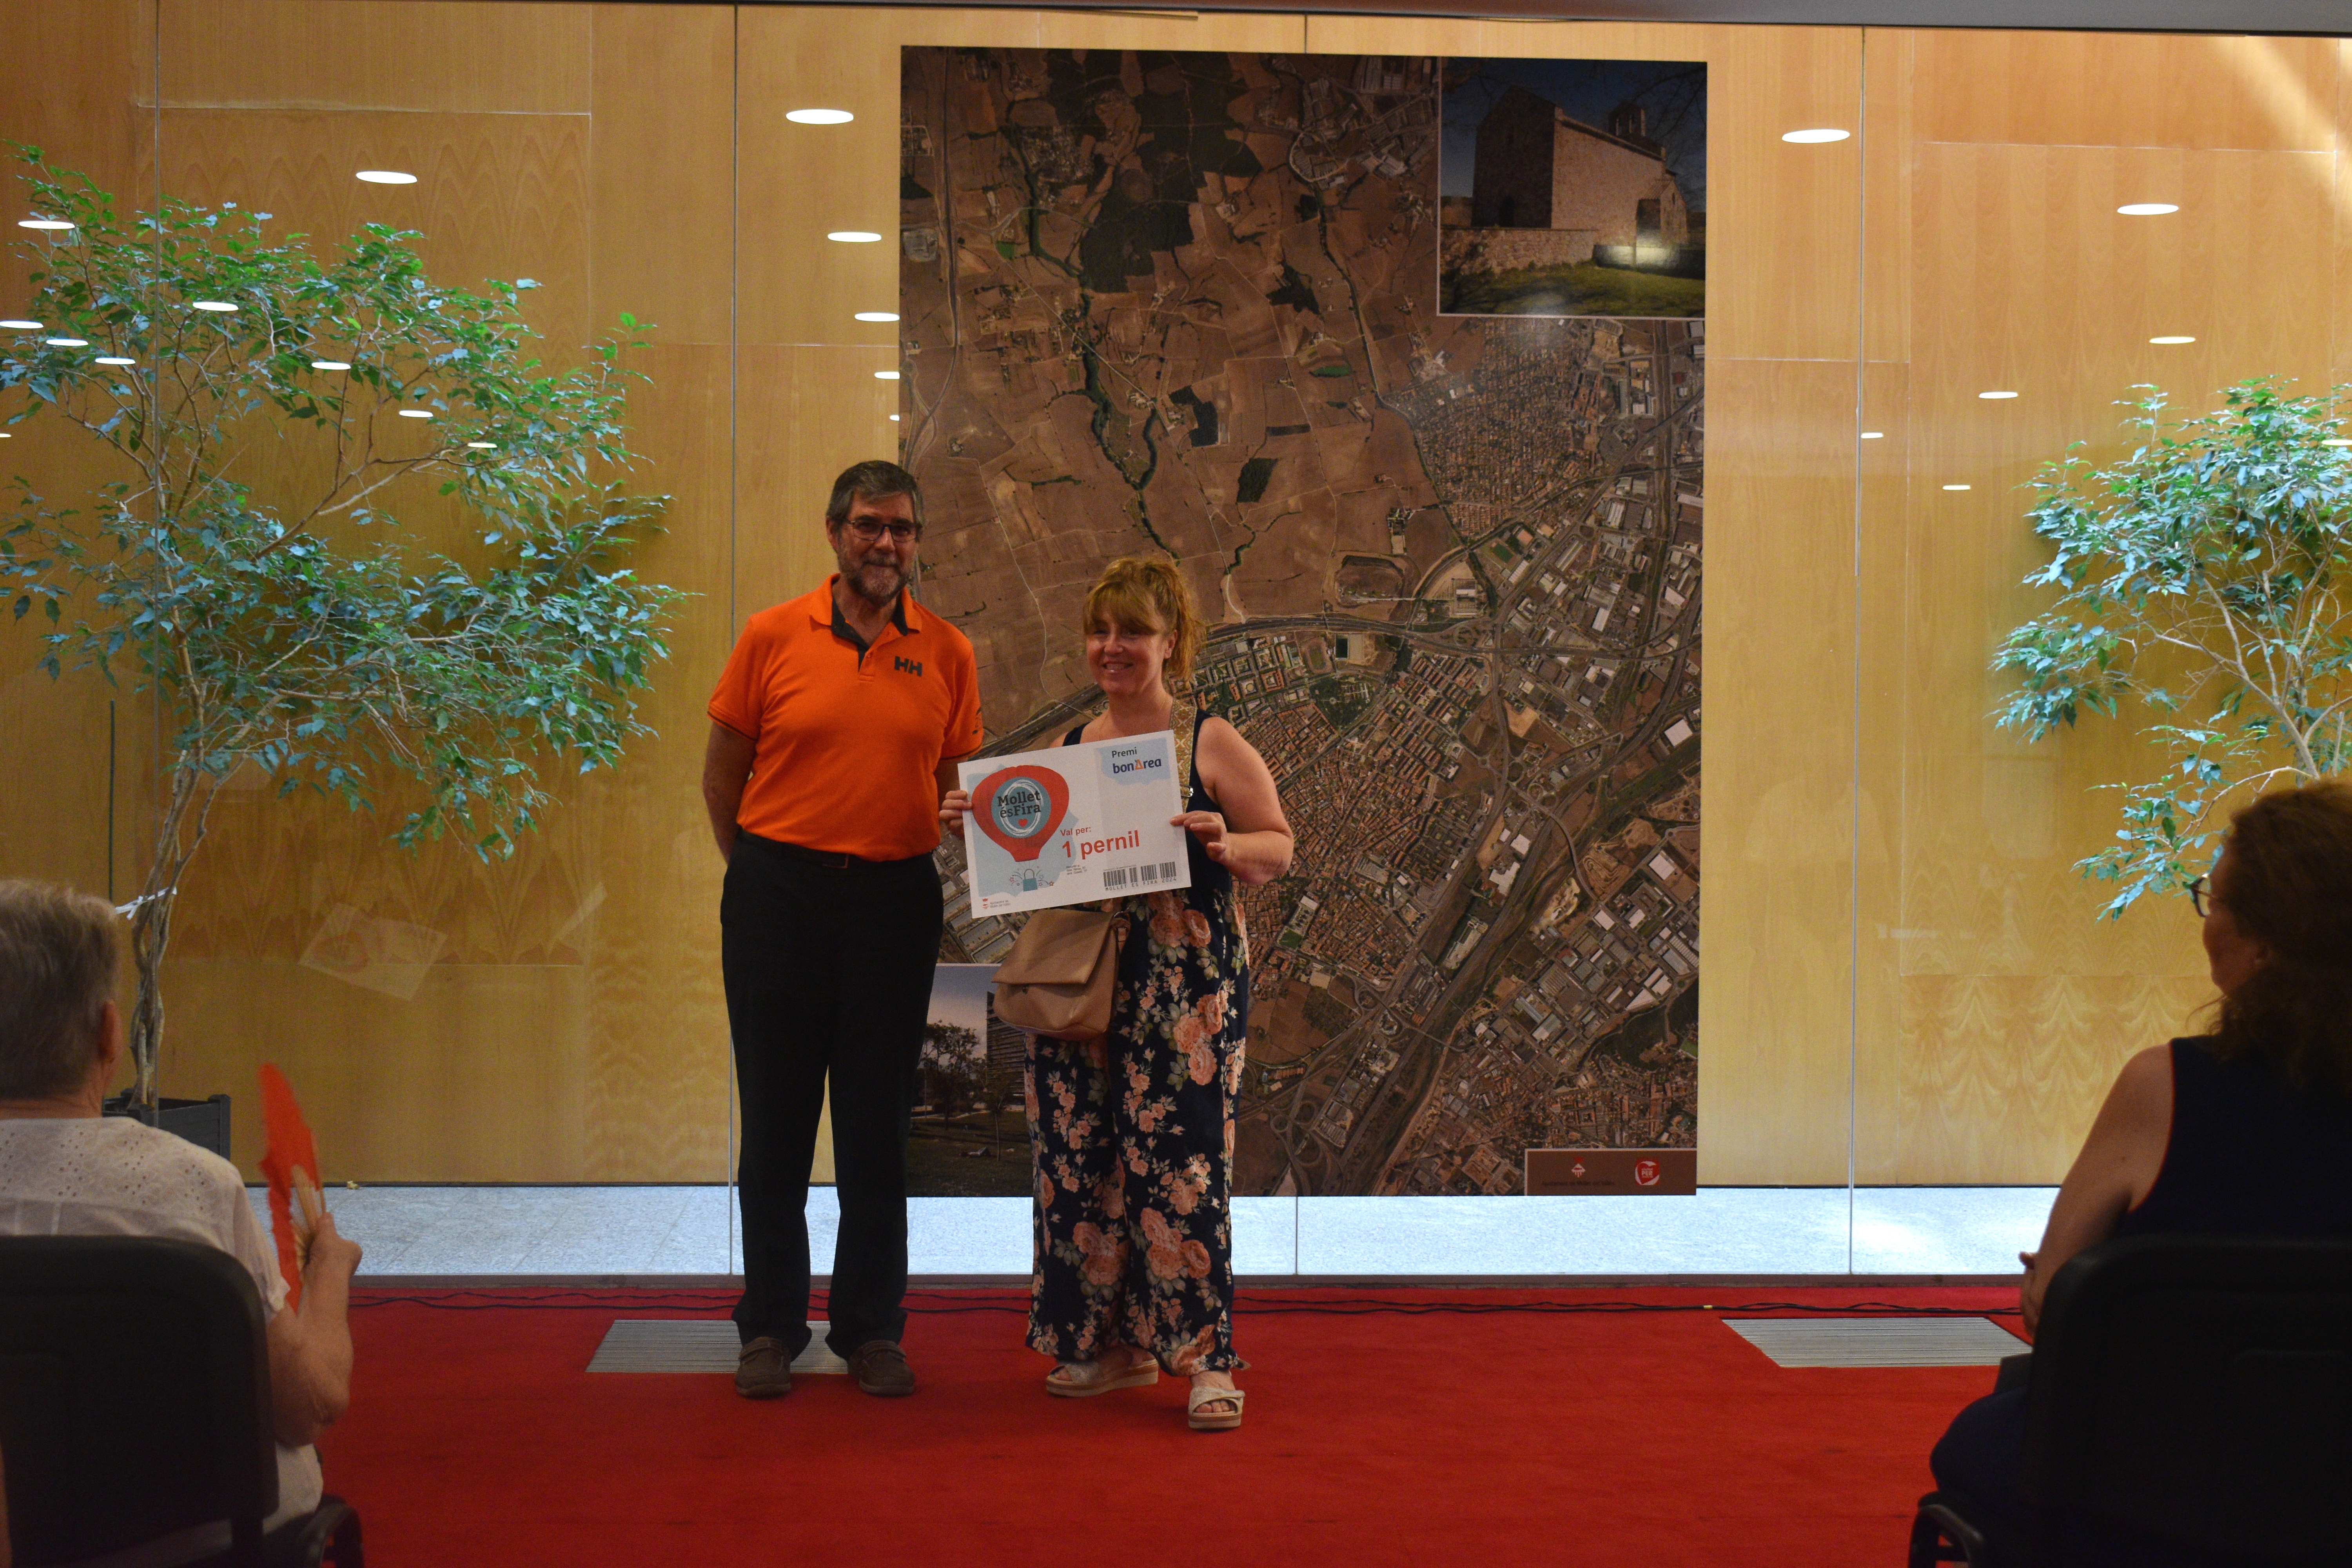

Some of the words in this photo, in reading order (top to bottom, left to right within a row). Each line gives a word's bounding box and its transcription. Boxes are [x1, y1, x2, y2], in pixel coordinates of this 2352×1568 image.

[895, 656, 922, 677] HH
[1112, 746, 1137, 758] Premi
[997, 790, 1041, 806] Mollet
[1076, 827, 1091, 836] per:
[1062, 841, 1071, 858] 1
[1081, 830, 1140, 860] pernil
